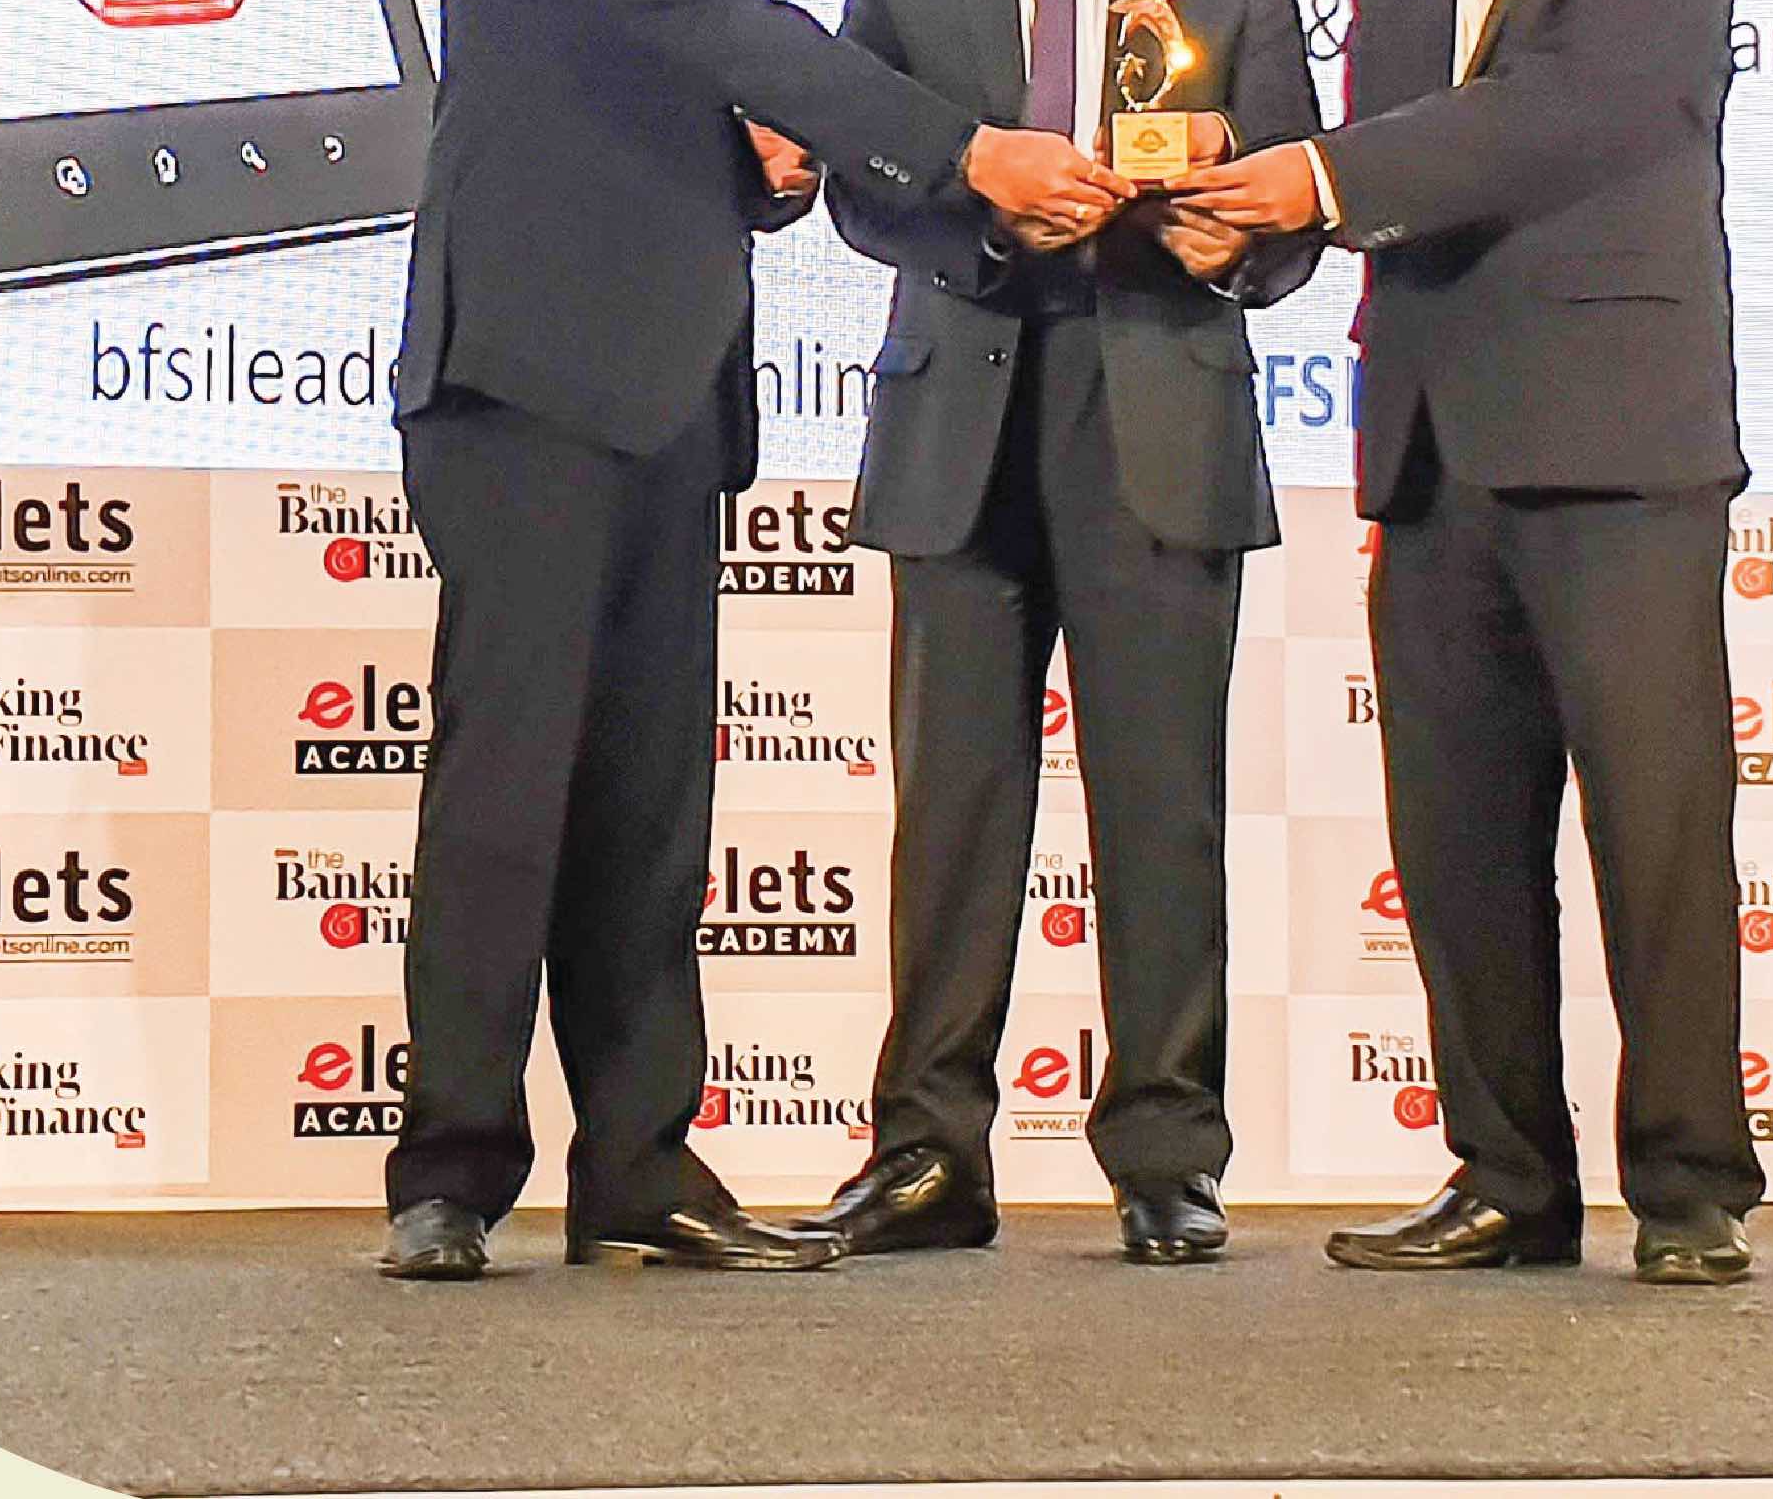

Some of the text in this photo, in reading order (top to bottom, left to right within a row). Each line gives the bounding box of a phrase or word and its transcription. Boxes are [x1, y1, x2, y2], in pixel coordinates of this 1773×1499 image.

[725, 490, 850, 553] lets
[718, 567, 848, 591] ADEMY
[696, 928, 850, 951] CADEMY
